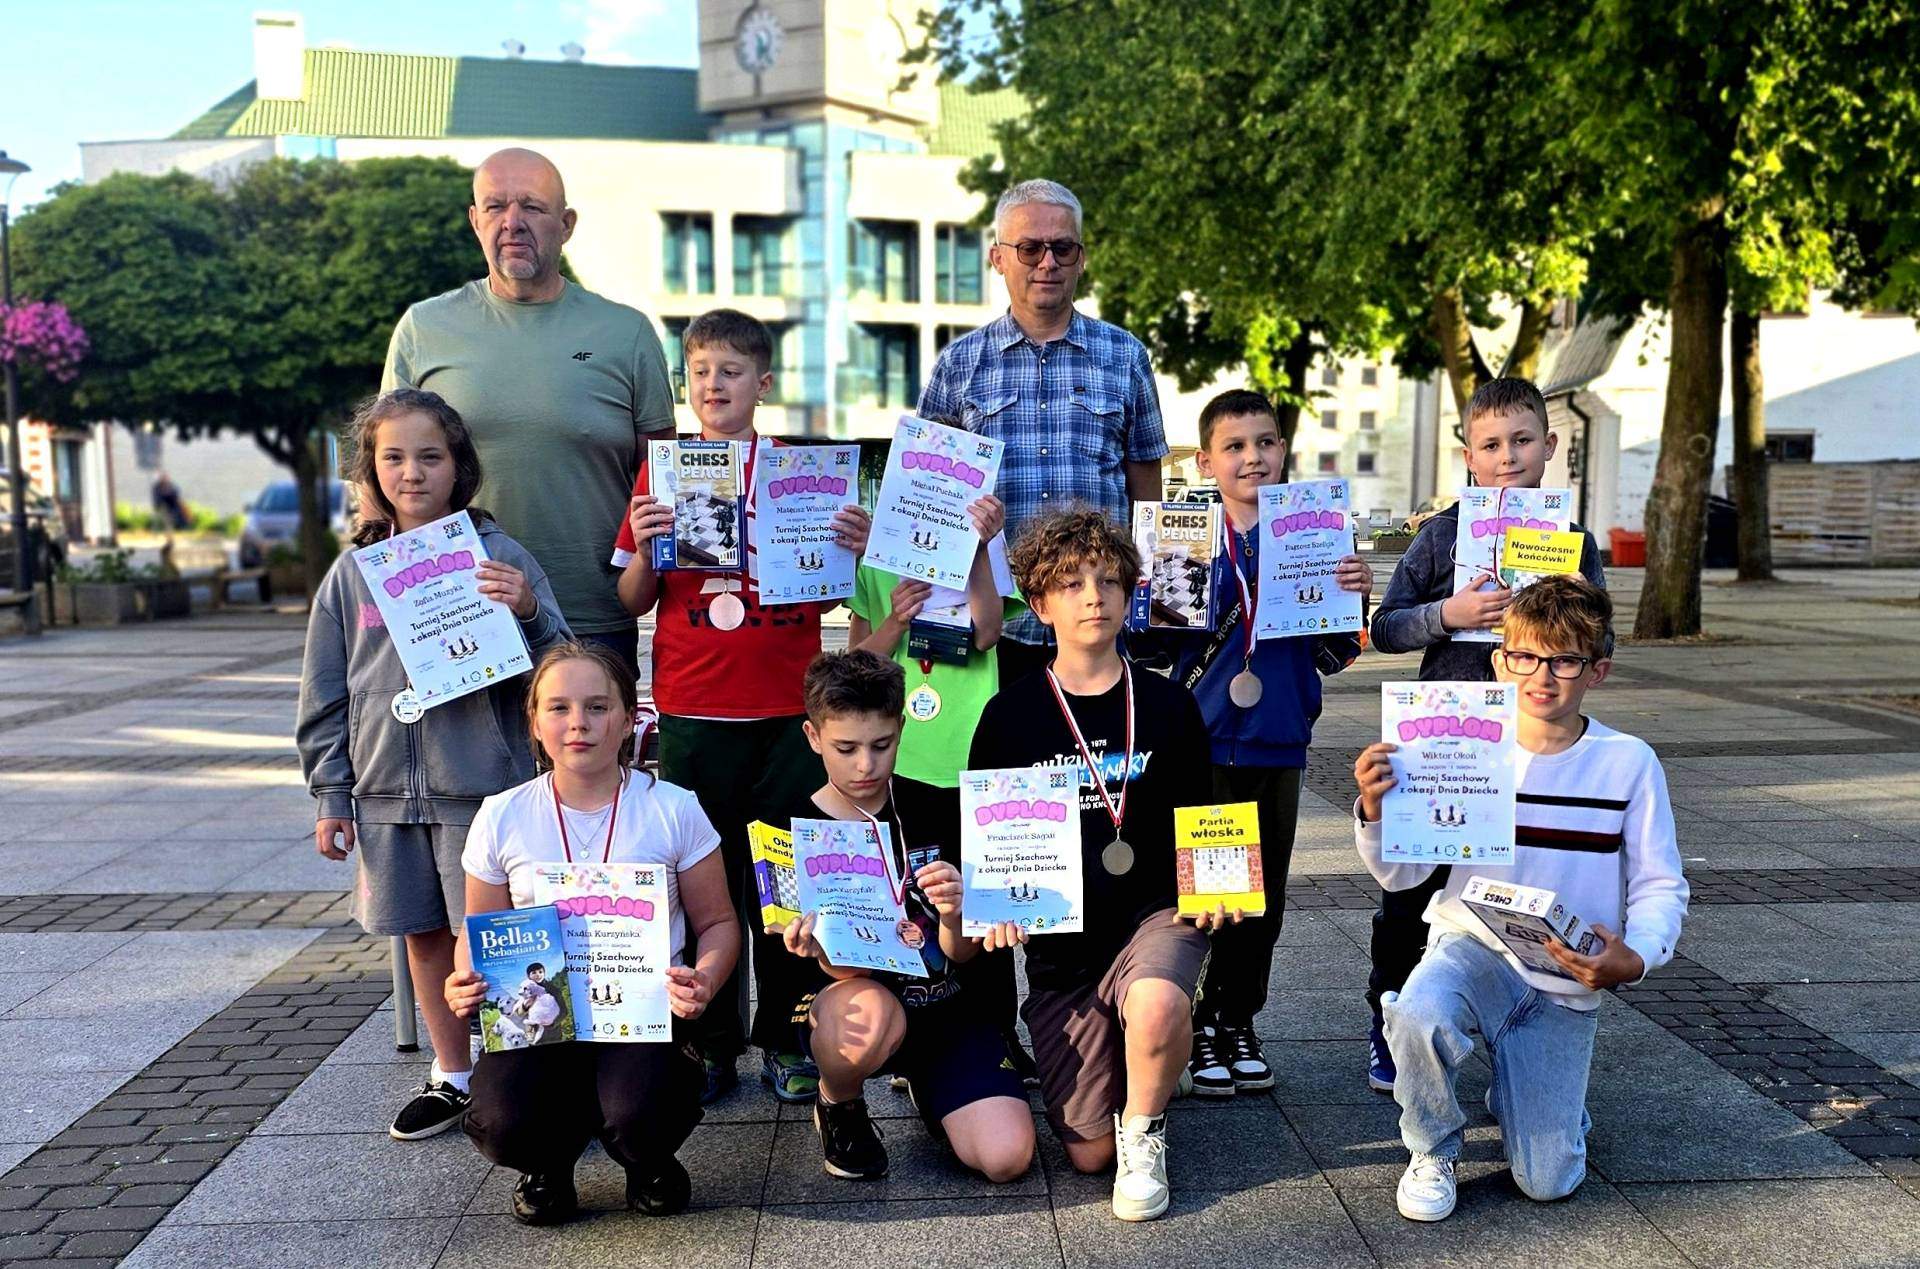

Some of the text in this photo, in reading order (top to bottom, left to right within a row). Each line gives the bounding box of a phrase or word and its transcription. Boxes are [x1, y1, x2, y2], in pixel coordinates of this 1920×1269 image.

[572, 351, 593, 362] 4F
[680, 453, 730, 466] CHESS
[680, 466, 730, 478] PEACE
[902, 450, 986, 488] DYPLOM
[768, 476, 848, 499] DYPLOM
[899, 496, 926, 510] Turniej
[927, 504, 965, 521] Szachowy
[898, 507, 920, 520] okazji
[922, 513, 940, 524] Dnia
[940, 518, 970, 532] Dziecka
[1162, 515, 1207, 528] CHESS
[1271, 511, 1344, 538] DYPLOM
[775, 525, 800, 534] Turniej
[1162, 528, 1207, 540] PEACE
[776, 536, 799, 546] okazji
[1512, 542, 1575, 554] Nowoczesne
[1518, 552, 1566, 562] końcówki
[1278, 559, 1342, 570] Turniej Szachowy
[383, 550, 475, 598] DYPLOM
[1278, 572, 1300, 580] okazji
[1302, 570, 1319, 578] Dnia
[410, 614, 440, 631] Turniej
[440, 600, 481, 620] Szachowy
[417, 626, 442, 642] okazji
[442, 620, 462, 632] Dnia
[462, 608, 494, 624] Dziecka
[1398, 716, 1502, 742] DYPLOM
[1422, 751, 1476, 760] Wiktor Okoń
[1406, 773, 1490, 784] Turniej Szachowy
[1408, 786, 1436, 795] okazji
[1438, 786, 1460, 794] Dnia
[1462, 786, 1498, 794] Dziecka
[975, 800, 1067, 826] DYPLOM
[1199, 817, 1234, 826] Partia
[1191, 827, 1244, 838] włoska
[984, 852, 1058, 864] Turniej Szachowy
[805, 853, 884, 878] DYPLOM
[985, 866, 1010, 874] okazji
[1013, 864, 1032, 872] Dnia
[1034, 863, 1066, 872] Dziecka
[1483, 892, 1512, 905] CHESS
[552, 895, 654, 922] DYPLOM
[480, 927, 550, 950] Bella 3
[567, 929, 640, 939] Nadia Kurzyńska
[482, 945, 535, 959] i Sebastian
[564, 952, 644, 963] Turniej Szachowy
[564, 964, 654, 974] okazji Dnia Dziecka
